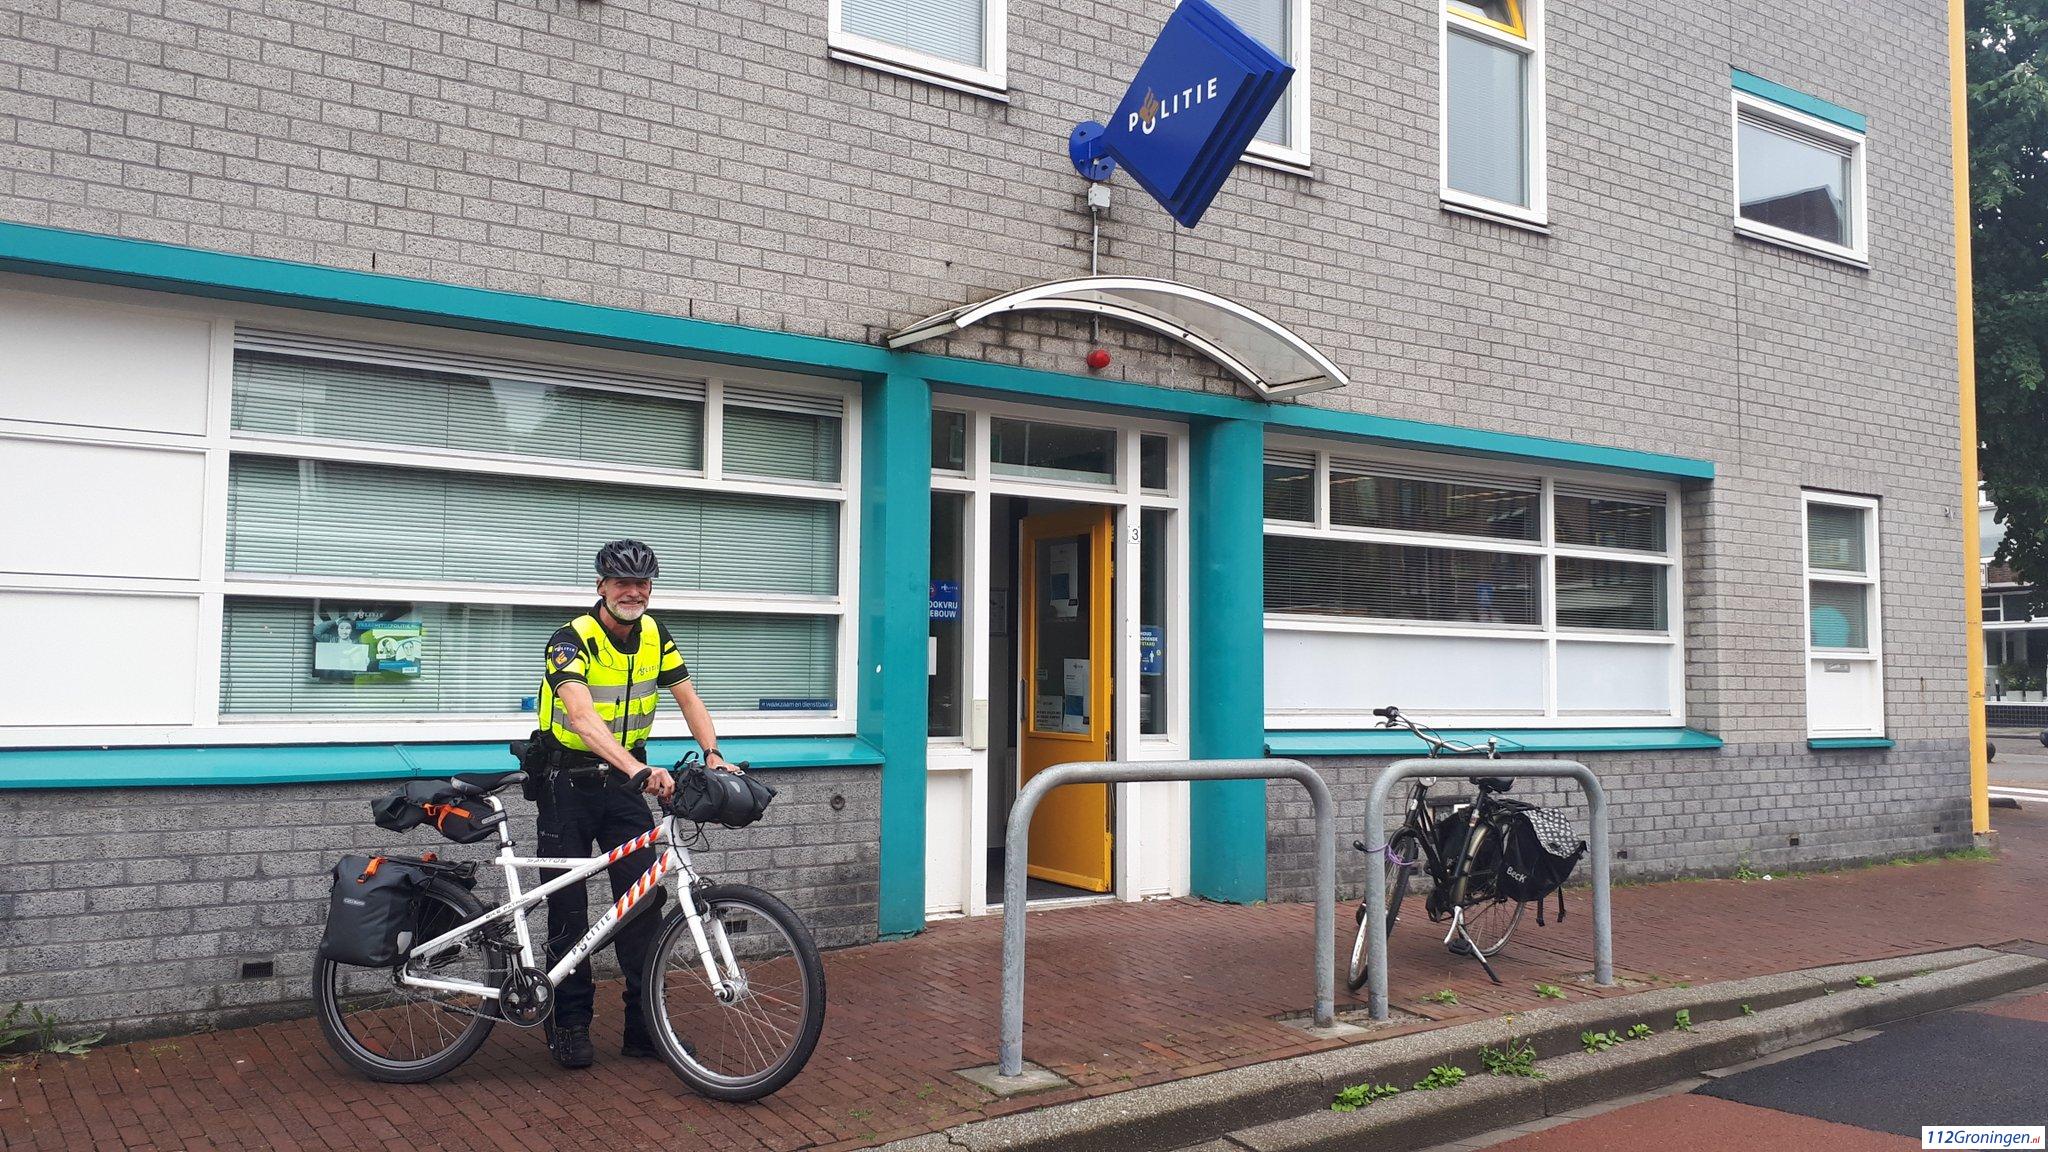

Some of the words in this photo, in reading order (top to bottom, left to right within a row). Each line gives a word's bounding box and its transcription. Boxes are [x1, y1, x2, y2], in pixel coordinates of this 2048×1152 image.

[1129, 77, 1218, 135] POLITIE
[1131, 528, 1139, 541] 3
[928, 600, 958, 609] OOKVRIJ
[930, 609, 957, 618] EBOUW
[571, 913, 612, 956] POLITIE
